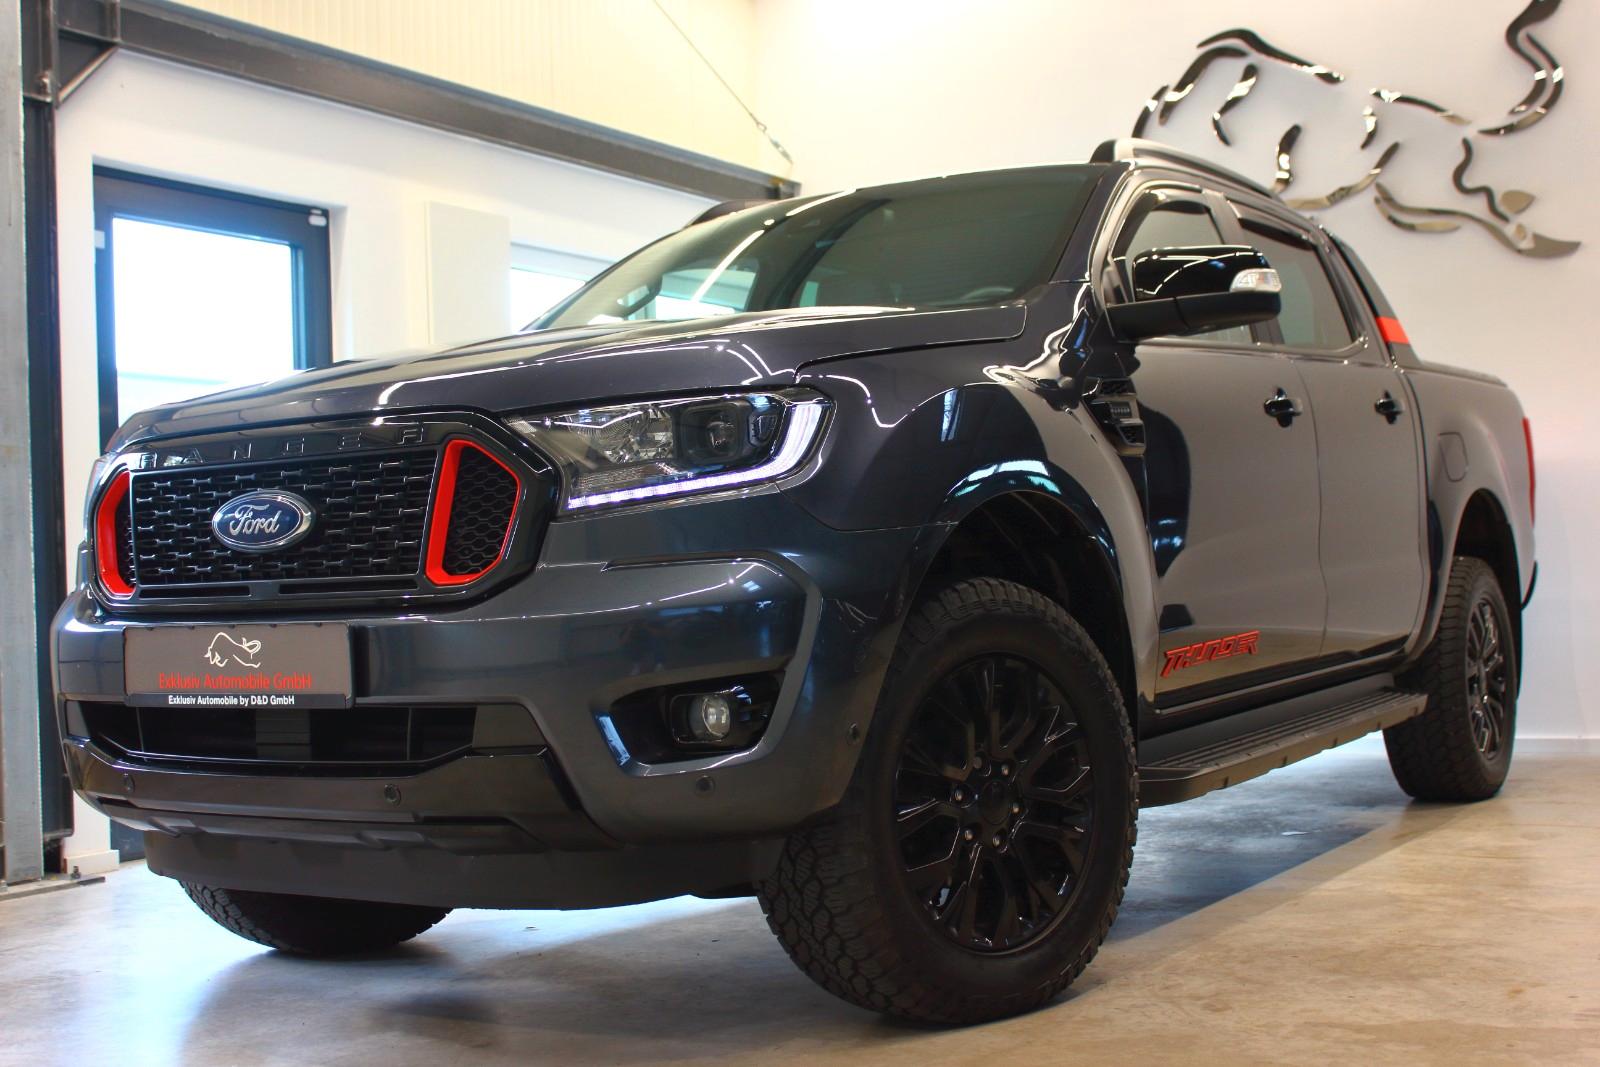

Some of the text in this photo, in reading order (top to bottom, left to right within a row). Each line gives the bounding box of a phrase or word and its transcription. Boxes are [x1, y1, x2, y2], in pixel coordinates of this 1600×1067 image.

[229, 504, 282, 536] Ford
[1160, 630, 1260, 678] THUNDER
[159, 672, 312, 689] Exklusiv Automobile GmbH
[168, 695, 295, 707] Exklusiv Automobile by D&D GmbH
